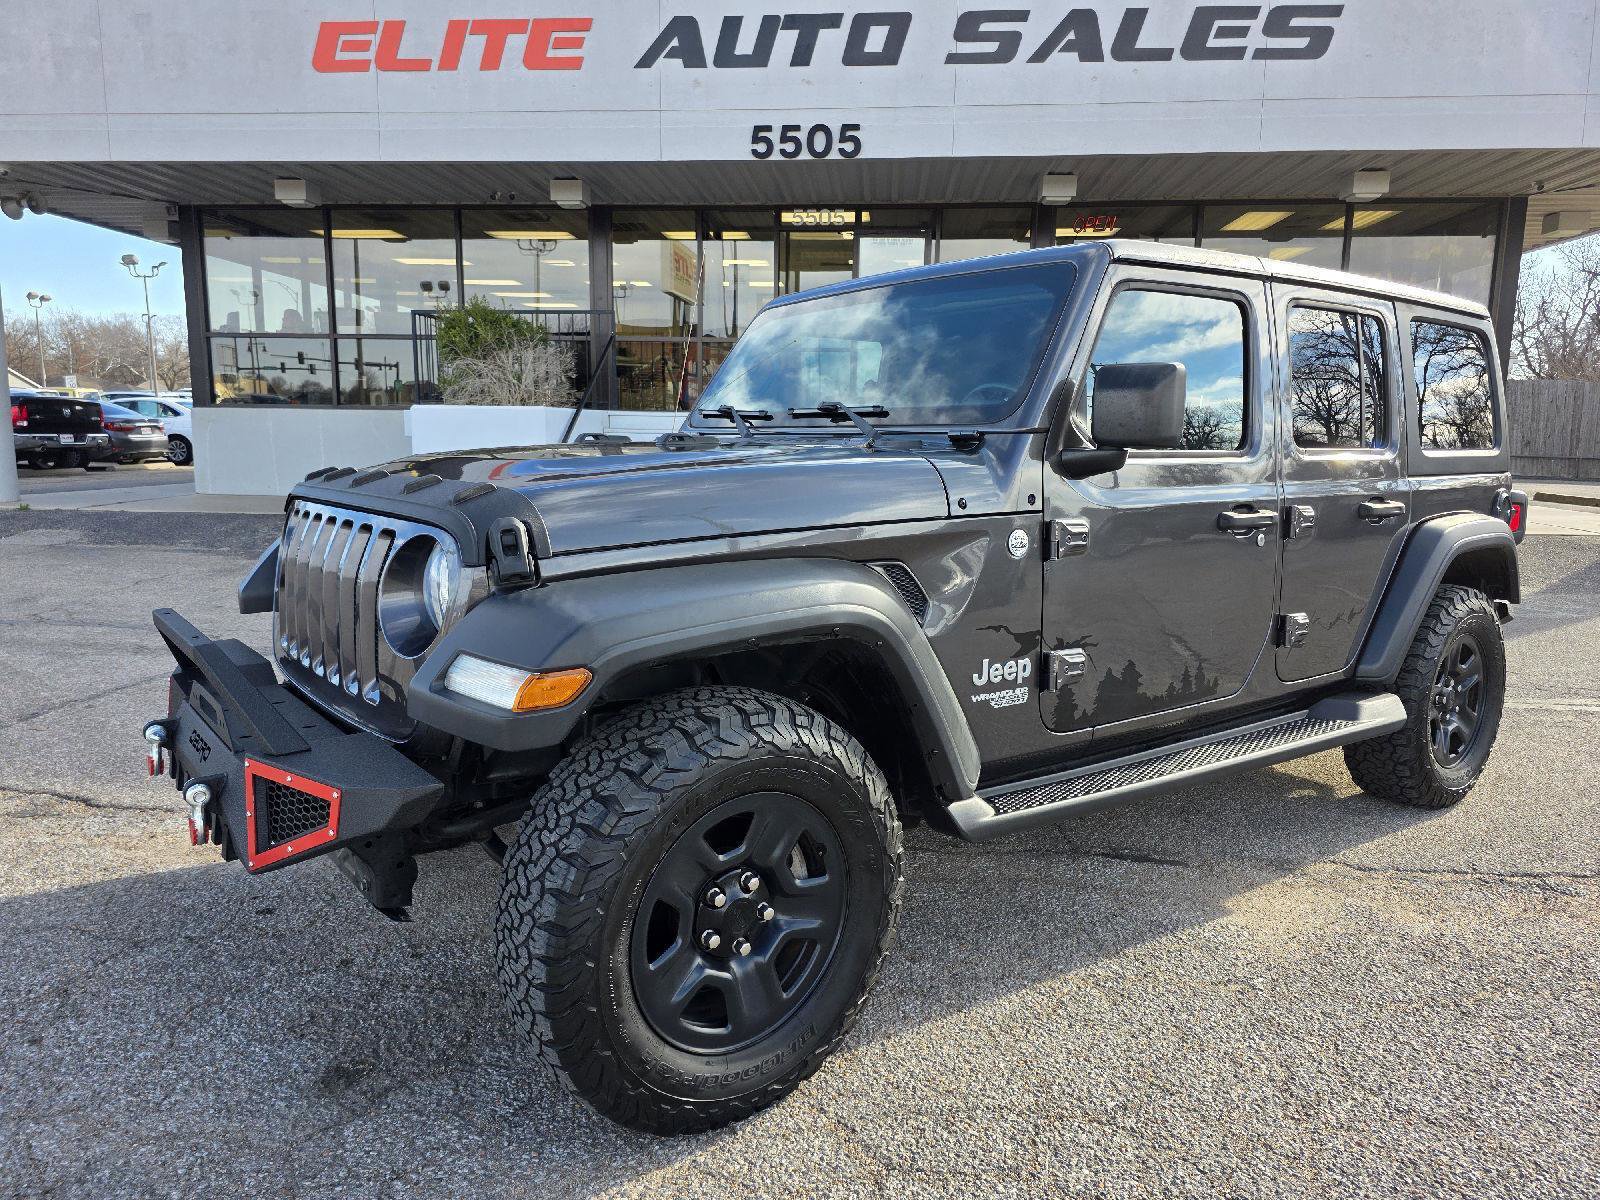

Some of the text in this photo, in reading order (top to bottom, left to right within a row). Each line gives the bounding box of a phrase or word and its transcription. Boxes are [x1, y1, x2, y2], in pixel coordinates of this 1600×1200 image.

[311, 4, 1345, 73] ELITE AUTO SALES
[750, 123, 862, 160] 5505
[791, 208, 846, 226] 5505
[1072, 214, 1118, 234] OPEN
[972, 657, 1032, 687] Jeep
